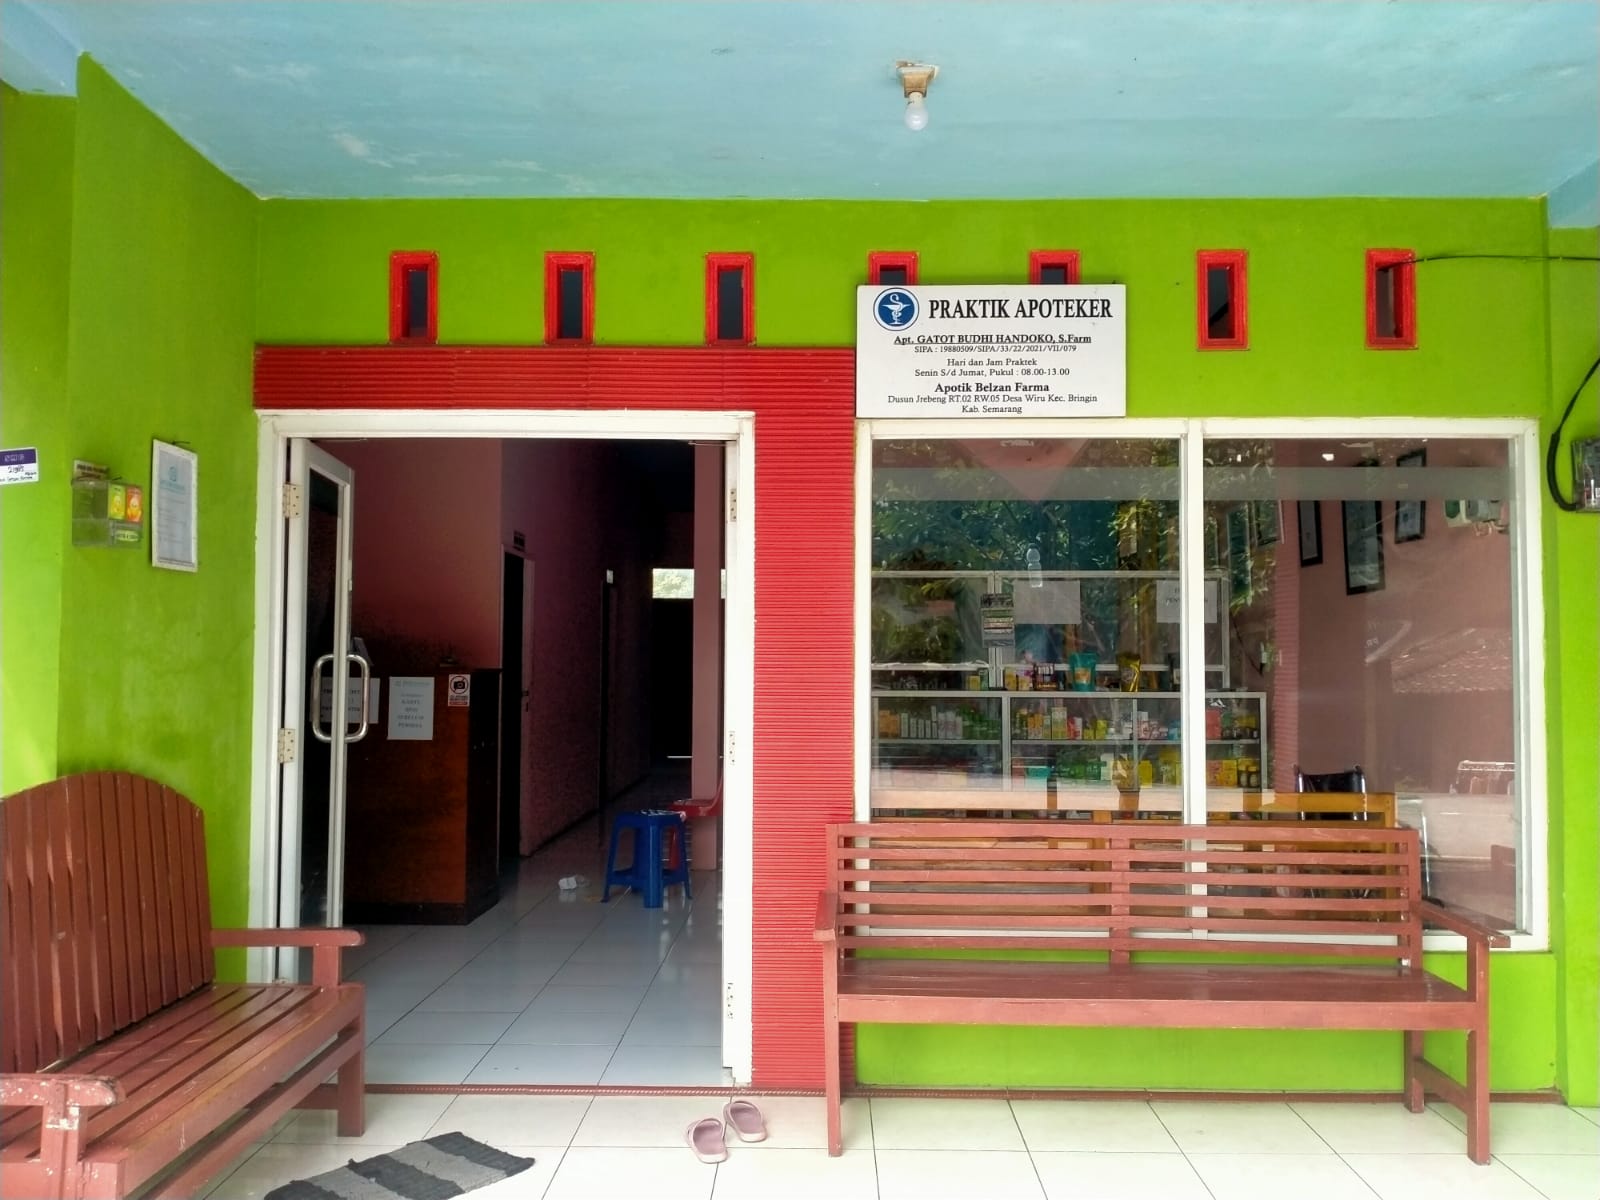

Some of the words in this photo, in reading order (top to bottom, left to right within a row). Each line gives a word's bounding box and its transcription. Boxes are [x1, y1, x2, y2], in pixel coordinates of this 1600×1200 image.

[929, 299, 1010, 318] PRAKTIK
[1015, 299, 1113, 318] APOTEKER
[894, 336, 913, 345] Apt.
[917, 335, 954, 344] GATOT
[958, 335, 992, 343] BUDHI
[996, 335, 1056, 344] HANDOKO,
[1058, 335, 1091, 343] S.Farm
[947, 358, 966, 366] Hari
[969, 358, 983, 366] dan
[986, 358, 1003, 366] Jam
[1006, 358, 1037, 366] Praktek
[1021, 368, 1070, 376] 08.00-13.00
[935, 383, 972, 394] Apotik
[975, 383, 1011, 392] Belzan
[1015, 383, 1049, 392] Farma
[888, 395, 914, 403] Dusun
[916, 395, 946, 405] Jrebeng
[1068, 395, 1098, 403] Bringin
[983, 405, 1022, 414] Semarang
